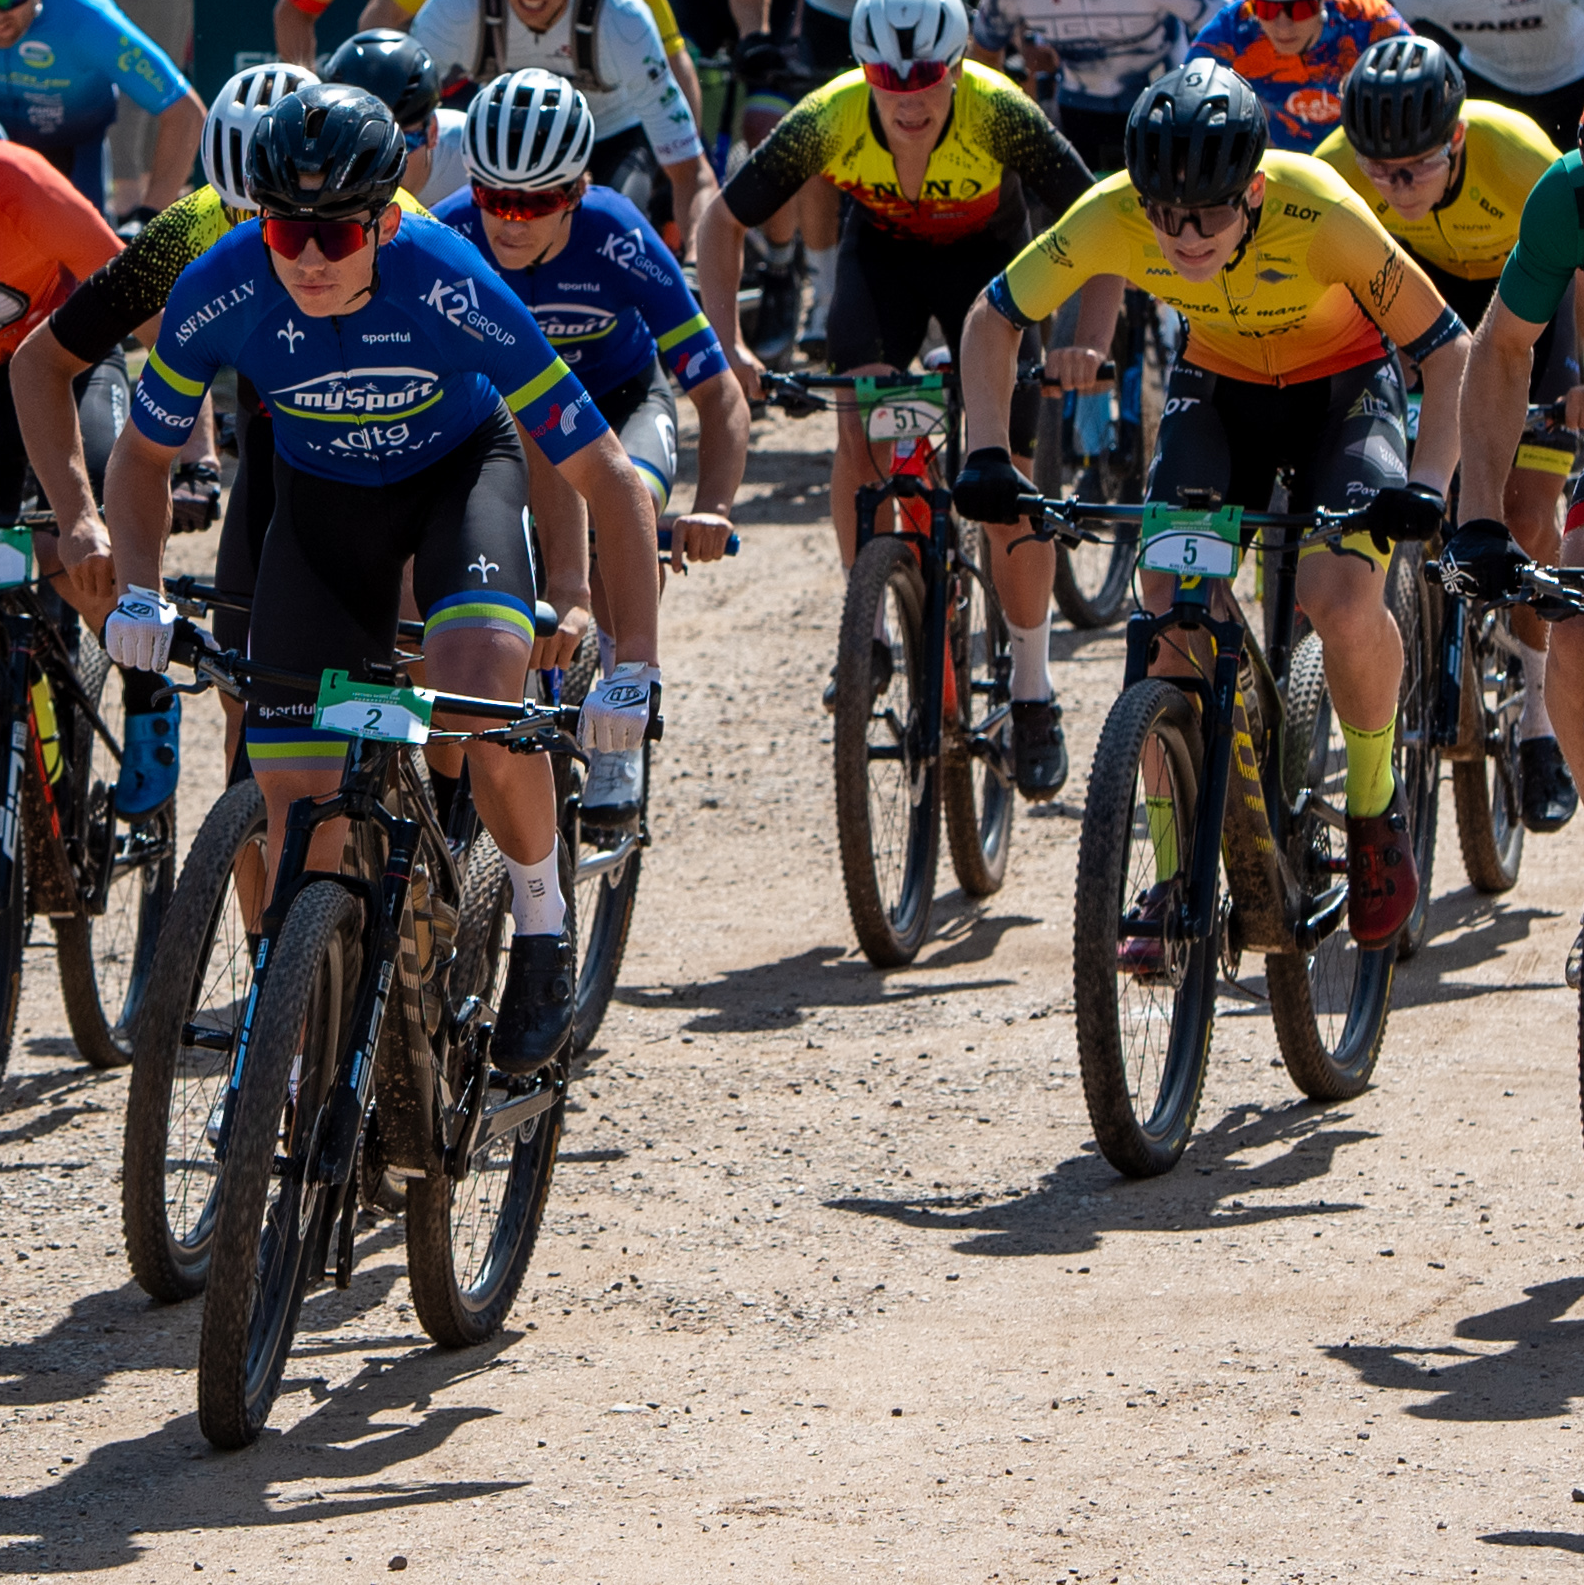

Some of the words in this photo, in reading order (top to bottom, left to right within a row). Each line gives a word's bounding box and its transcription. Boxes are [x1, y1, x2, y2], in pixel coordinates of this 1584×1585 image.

[1283, 203, 1321, 222] ELOT
[635, 255, 674, 287] GROUP
[174, 279, 256, 348] ASFALT.LV
[362, 331, 411, 344] sportful
[466, 309, 516, 348] GROUP
[293, 381, 434, 412] mySport
[1183, 538, 1197, 565] 5
[363, 708, 383, 731] 2
